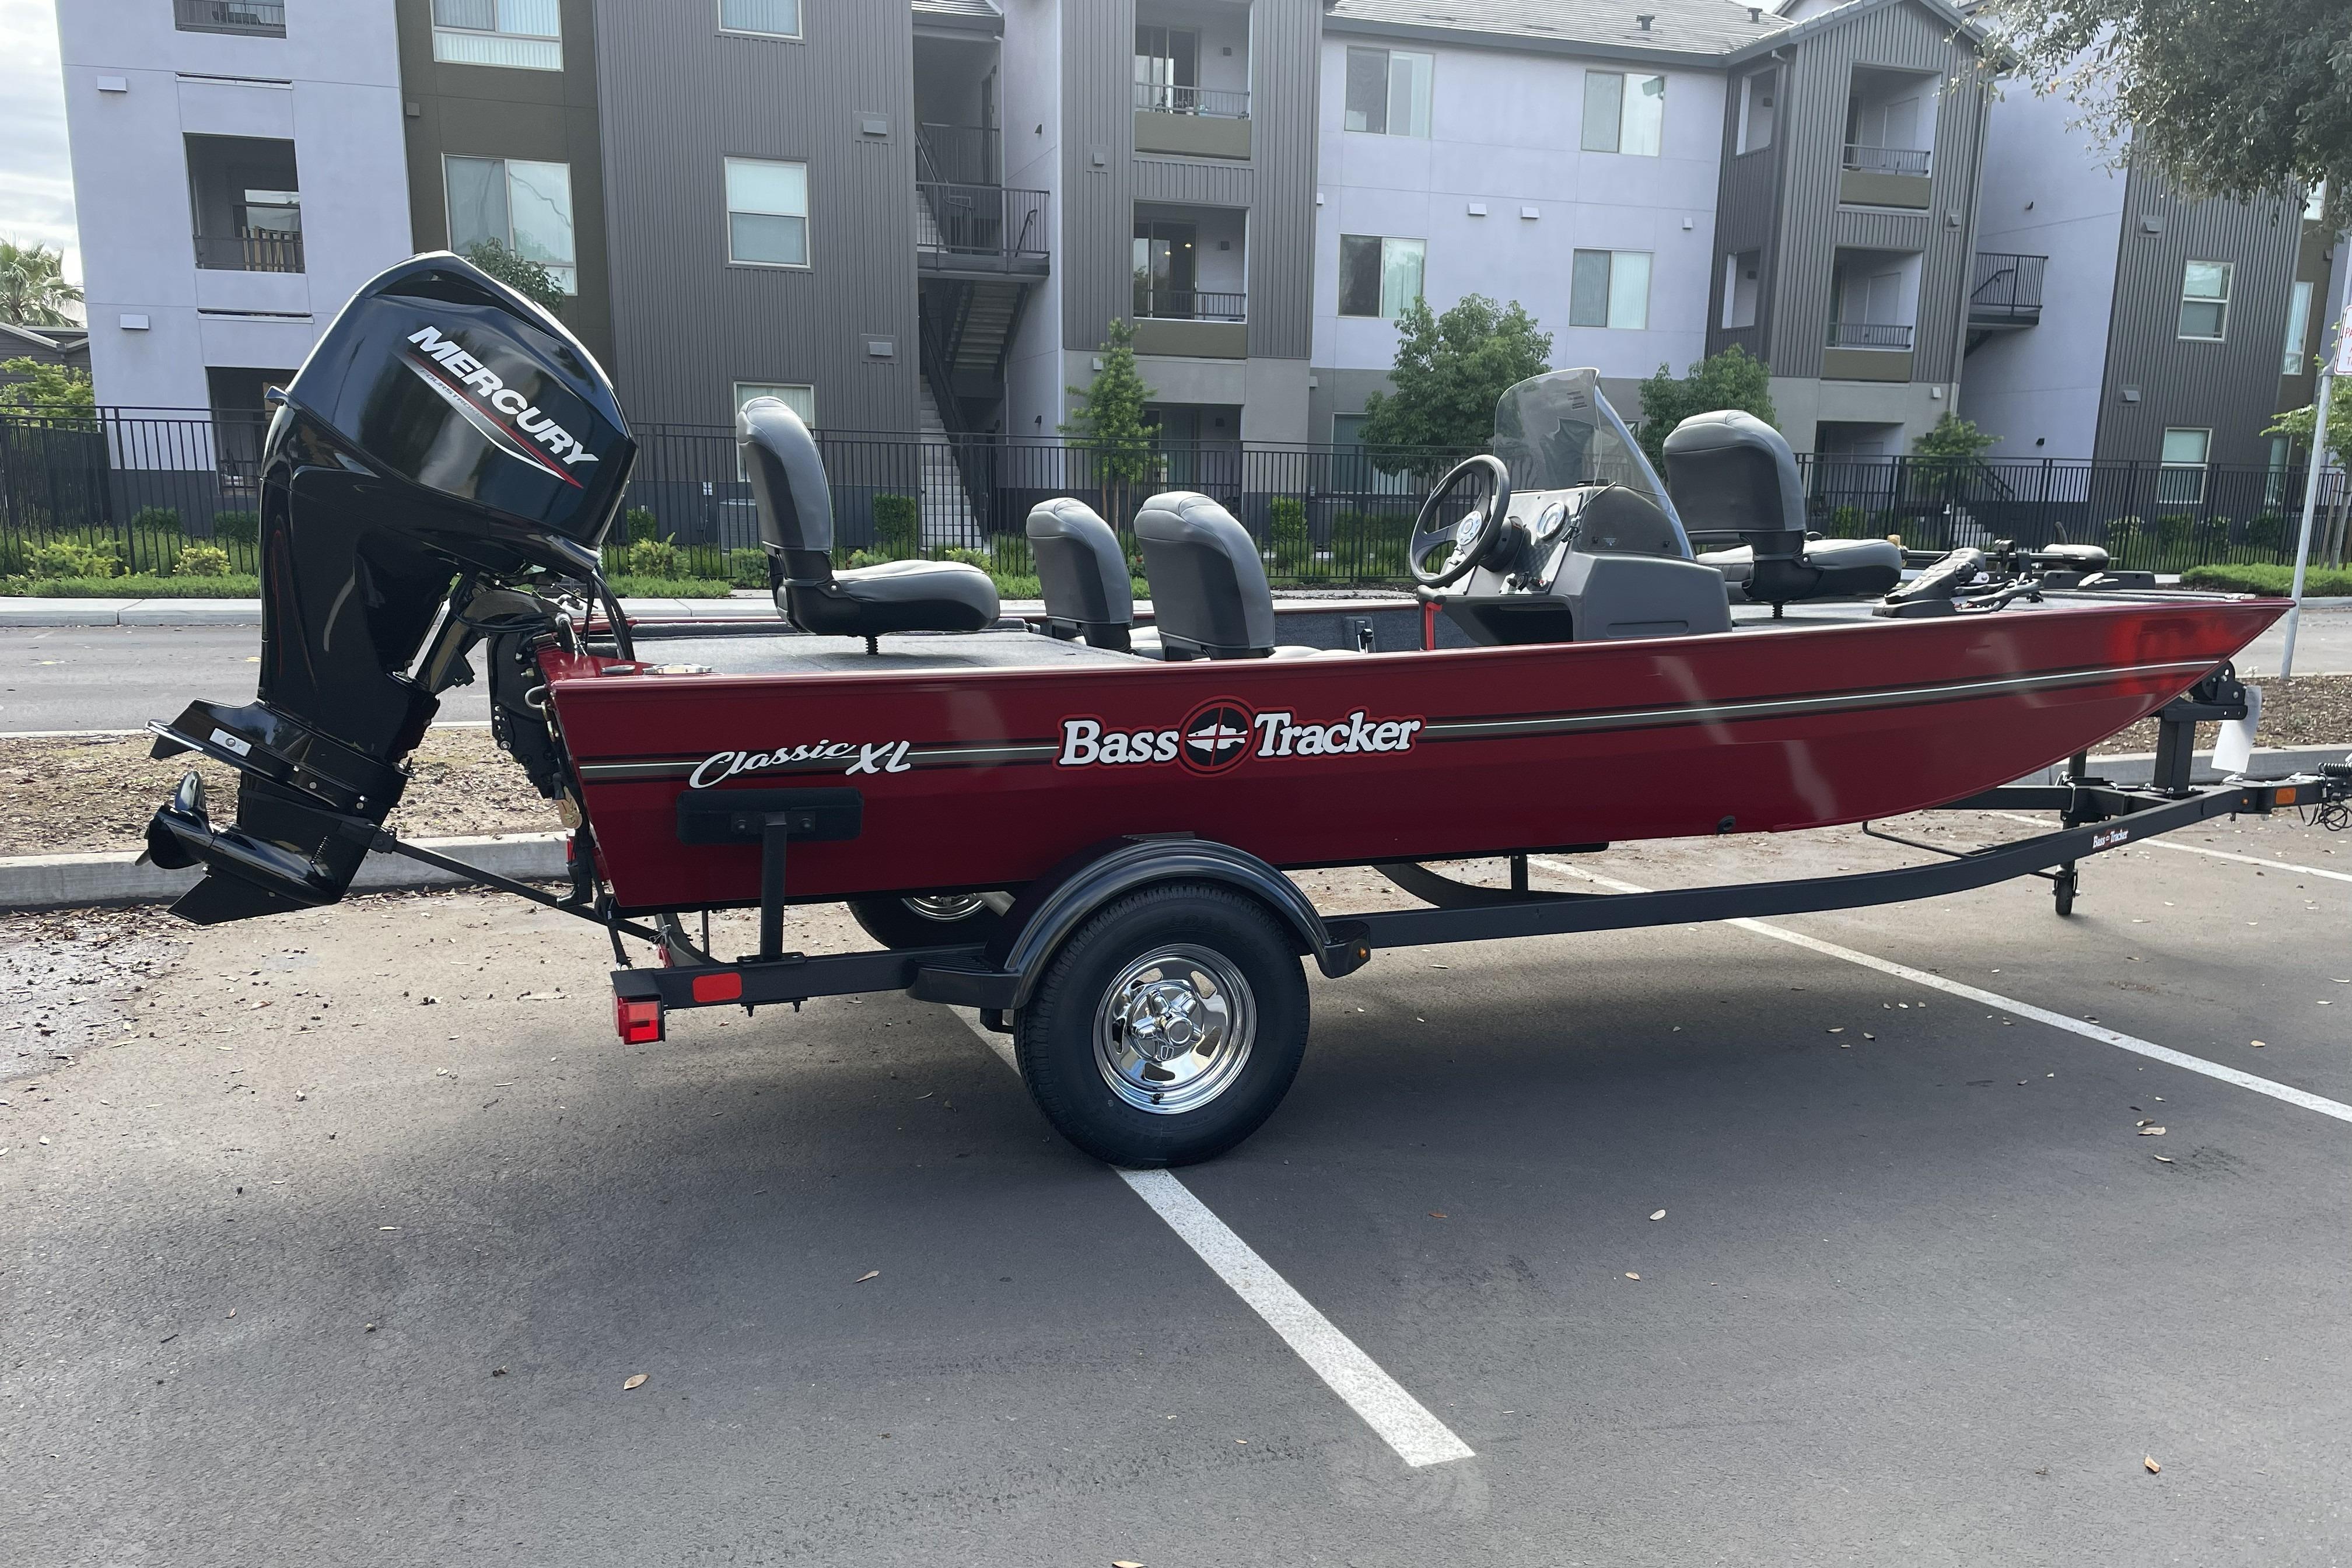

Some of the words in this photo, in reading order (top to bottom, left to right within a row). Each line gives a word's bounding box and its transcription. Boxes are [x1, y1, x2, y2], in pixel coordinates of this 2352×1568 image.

[407, 326, 600, 465] MERCURY
[419, 369, 485, 419] FOURSTROKE
[1058, 720, 1179, 765] Bass
[1254, 710, 1422, 757] Tracker
[689, 739, 857, 789] Classic
[845, 740, 911, 776] XL
[2093, 835, 2106, 849] Bass
